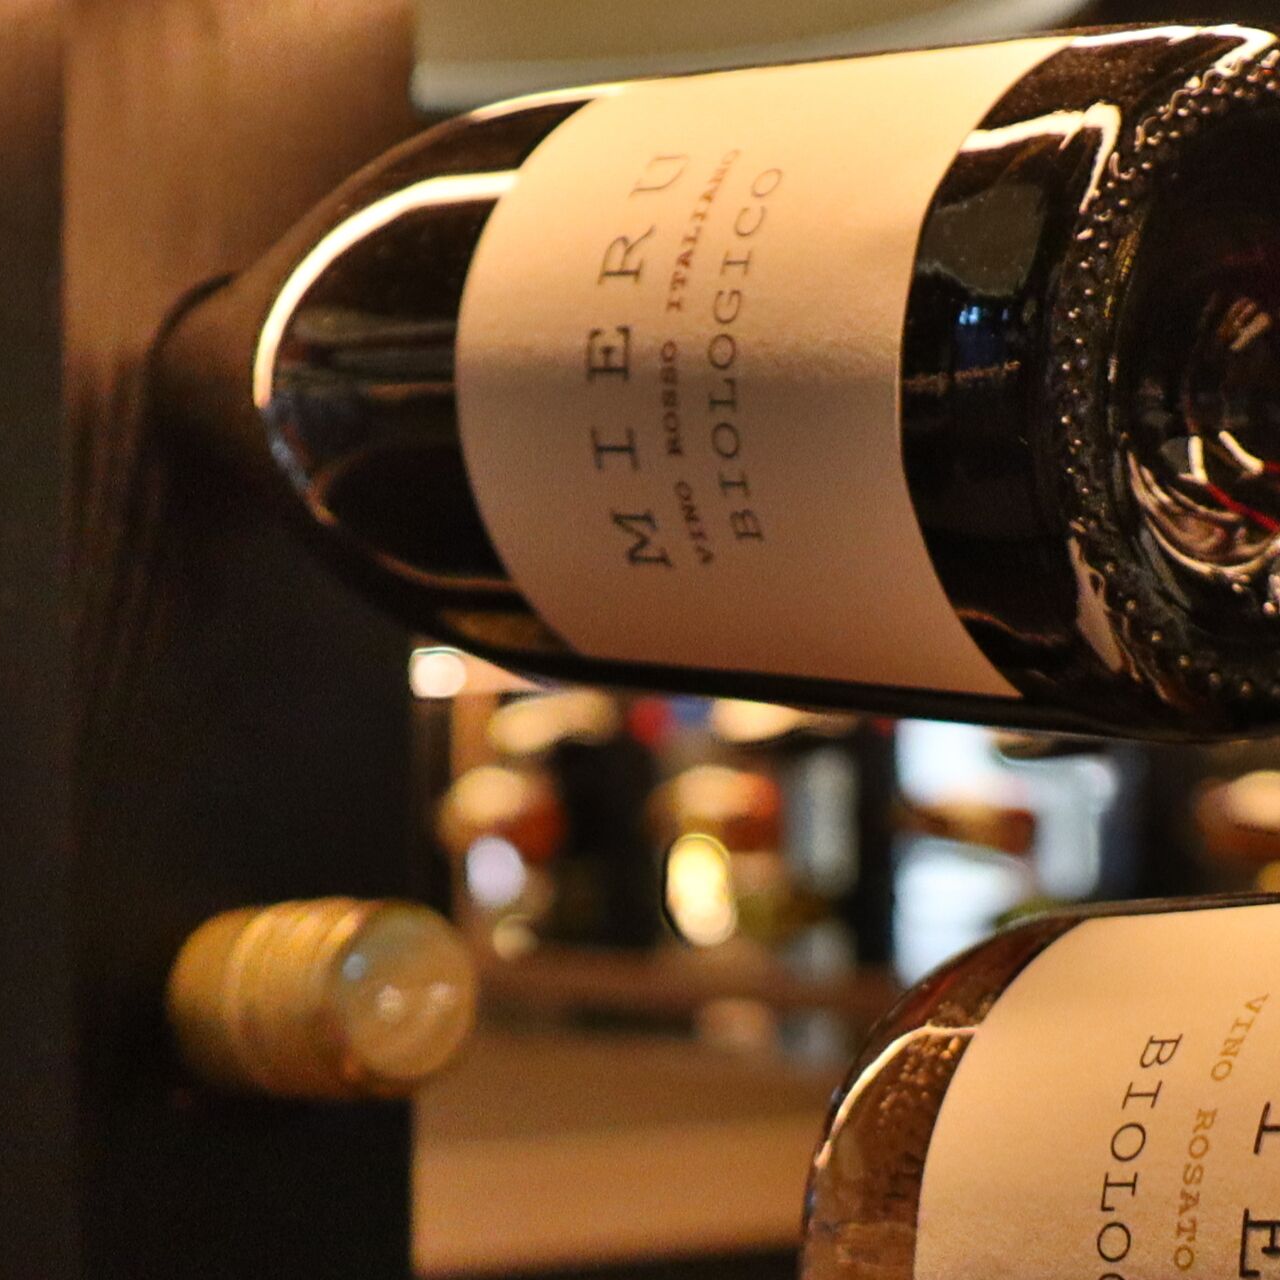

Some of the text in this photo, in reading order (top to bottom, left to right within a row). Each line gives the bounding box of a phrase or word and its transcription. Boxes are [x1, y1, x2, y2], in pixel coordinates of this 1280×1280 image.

[586, 152, 691, 570] MIERU
[660, 148, 742, 565] VINO ROSSO ITALIANO
[707, 167, 784, 543] BIOLOGICO
[1173, 1107, 1218, 1272] ROSATO
[1210, 993, 1270, 1082] VINO
